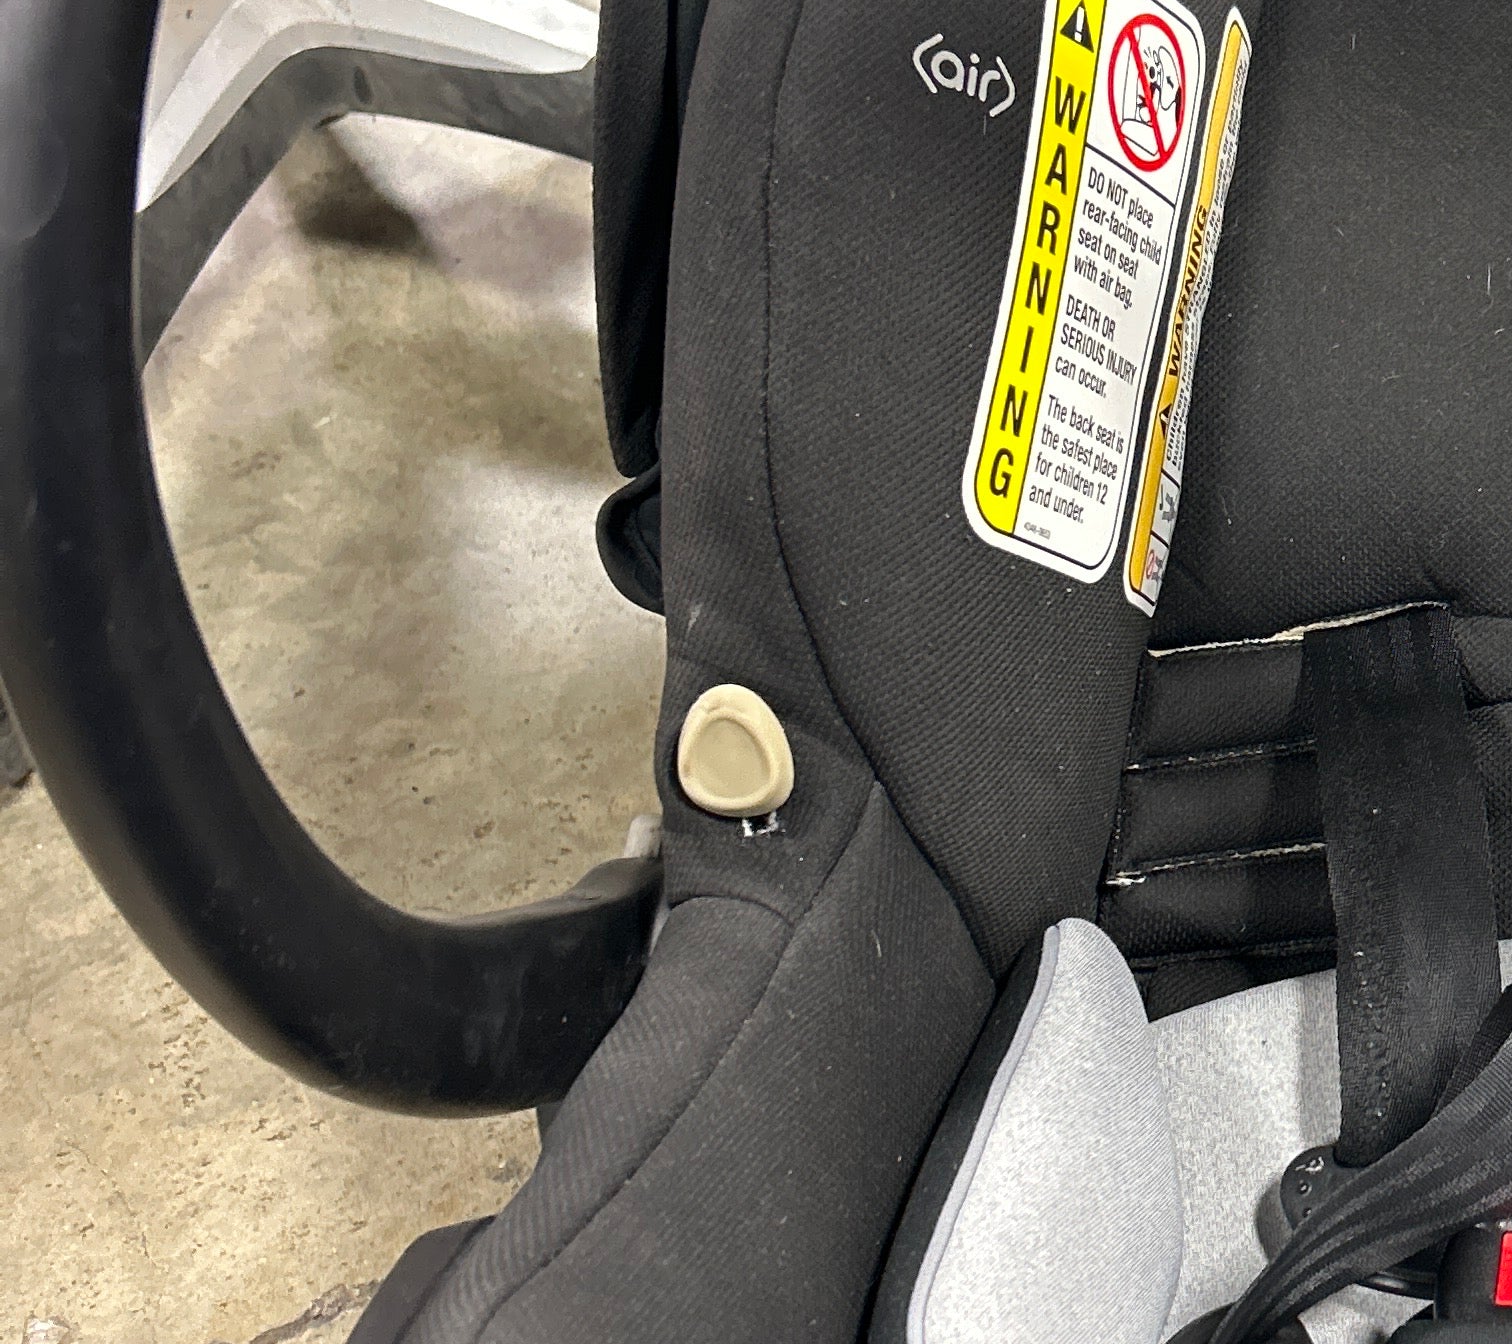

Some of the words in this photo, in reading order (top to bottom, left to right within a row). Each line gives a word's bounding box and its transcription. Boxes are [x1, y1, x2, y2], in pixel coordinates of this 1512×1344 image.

[1088, 166, 1105, 194] DO
[1106, 178, 1128, 209] NOT
[1127, 197, 1154, 229] place
[1077, 227, 1103, 256] seat
[1103, 243, 1117, 265] on
[1117, 252, 1139, 280] seat
[1082, 198, 1139, 253] rear-facing
[1139, 236, 1162, 266] child
[989, 76, 1086, 499] WARNING
[1073, 254, 1098, 284] with
[1099, 269, 1114, 293] air
[1114, 276, 1133, 310] bag.
[1168, 204, 1207, 378] WARNING
[1065, 294, 1101, 333] DEATH
[1102, 315, 1116, 342] OR
[1055, 356, 1077, 381] can
[1078, 367, 1107, 399] occur.
[1060, 322, 1106, 366] SERIOUS
[1105, 348, 1138, 386] INJURY
[1041, 423, 1060, 451] the
[1061, 437, 1094, 468] safest
[1092, 452, 1118, 481] place
[1047, 394, 1068, 424] The
[1069, 405, 1096, 438] back
[1095, 425, 1116, 450] seat
[1115, 431, 1124, 455] is
[1028, 484, 1054, 509] and
[1053, 496, 1085, 524] under.
[1035, 451, 1053, 478] for
[1053, 462, 1095, 499] children
[1096, 481, 1109, 505] 12
